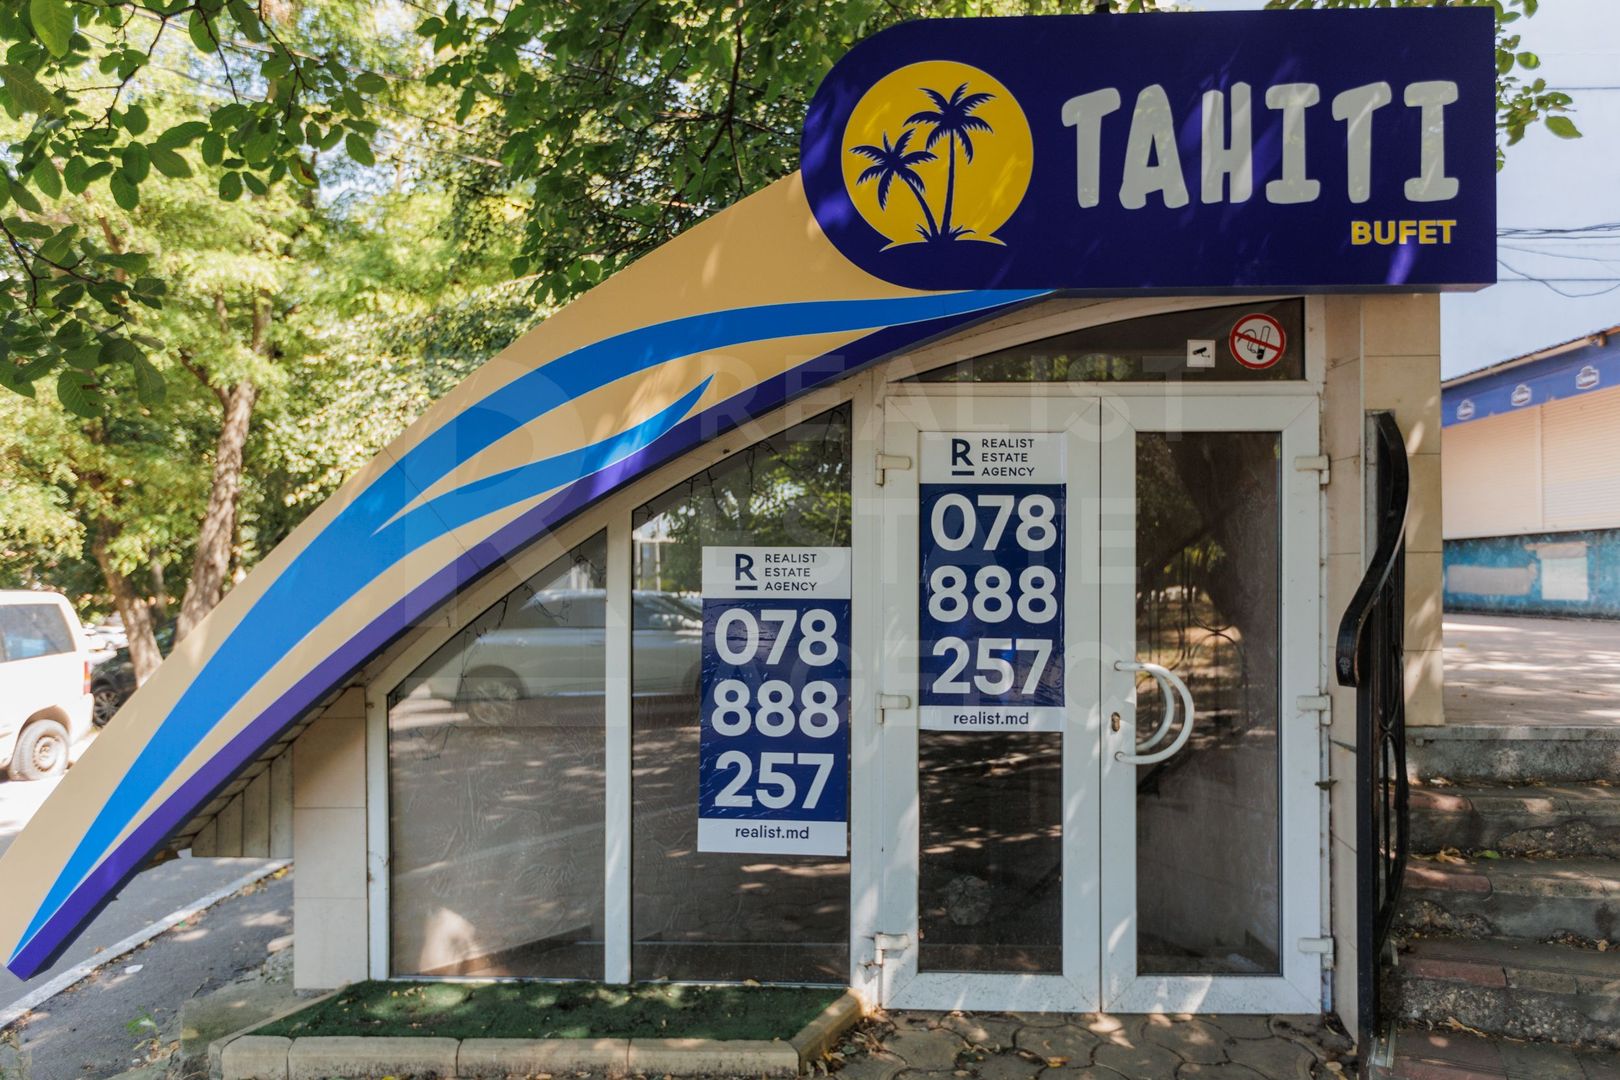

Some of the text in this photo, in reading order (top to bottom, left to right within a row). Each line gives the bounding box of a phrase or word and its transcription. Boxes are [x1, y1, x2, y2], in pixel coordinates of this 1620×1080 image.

[1060, 80, 1459, 210] TAHITI
[1350, 218, 1458, 246] BUFET
[981, 438, 1035, 449] REALIST
[981, 452, 1029, 463] ESTATE
[981, 467, 1036, 477] AGENCY
[930, 493, 1058, 552] 078
[764, 553, 817, 563] REALIST
[764, 567, 811, 577] ESTATE
[764, 581, 818, 592] AGENCY
[928, 565, 1058, 624] 888
[714, 608, 839, 667] 078
[932, 636, 1053, 695] 257
[711, 679, 840, 739] 888
[953, 711, 1029, 726] realist.md
[714, 750, 835, 810] 257
[735, 824, 810, 840] realist.md
